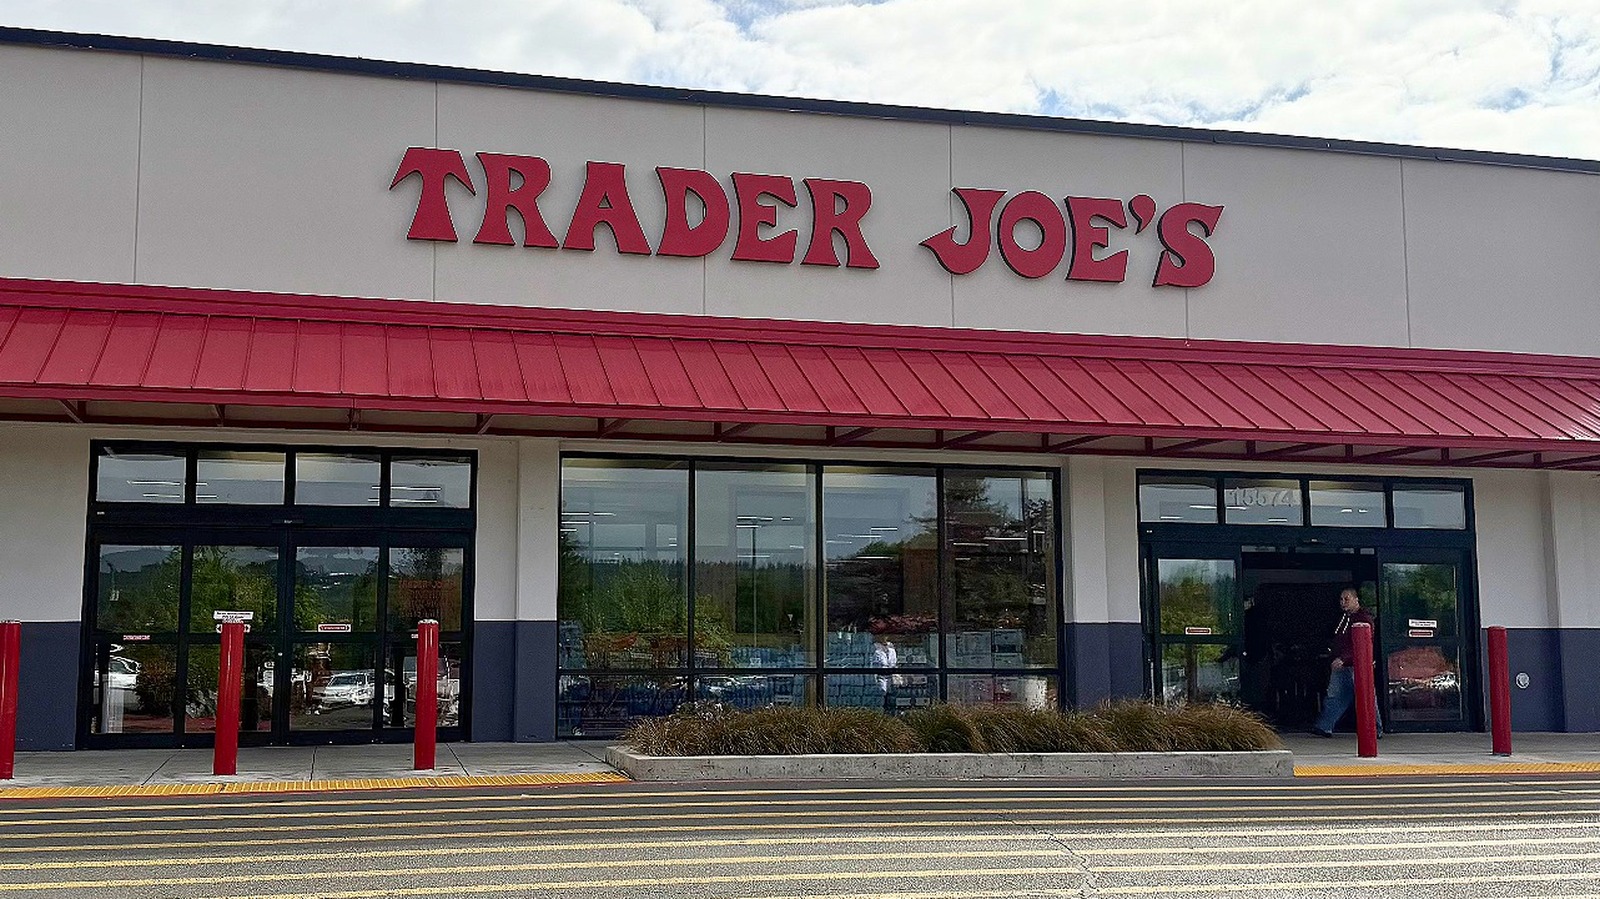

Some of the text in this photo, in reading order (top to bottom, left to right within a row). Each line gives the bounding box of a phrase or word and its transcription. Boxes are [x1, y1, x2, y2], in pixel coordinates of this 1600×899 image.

[389, 147, 1225, 288] TRADER JOE'S
[1229, 487, 1295, 507] 15574
